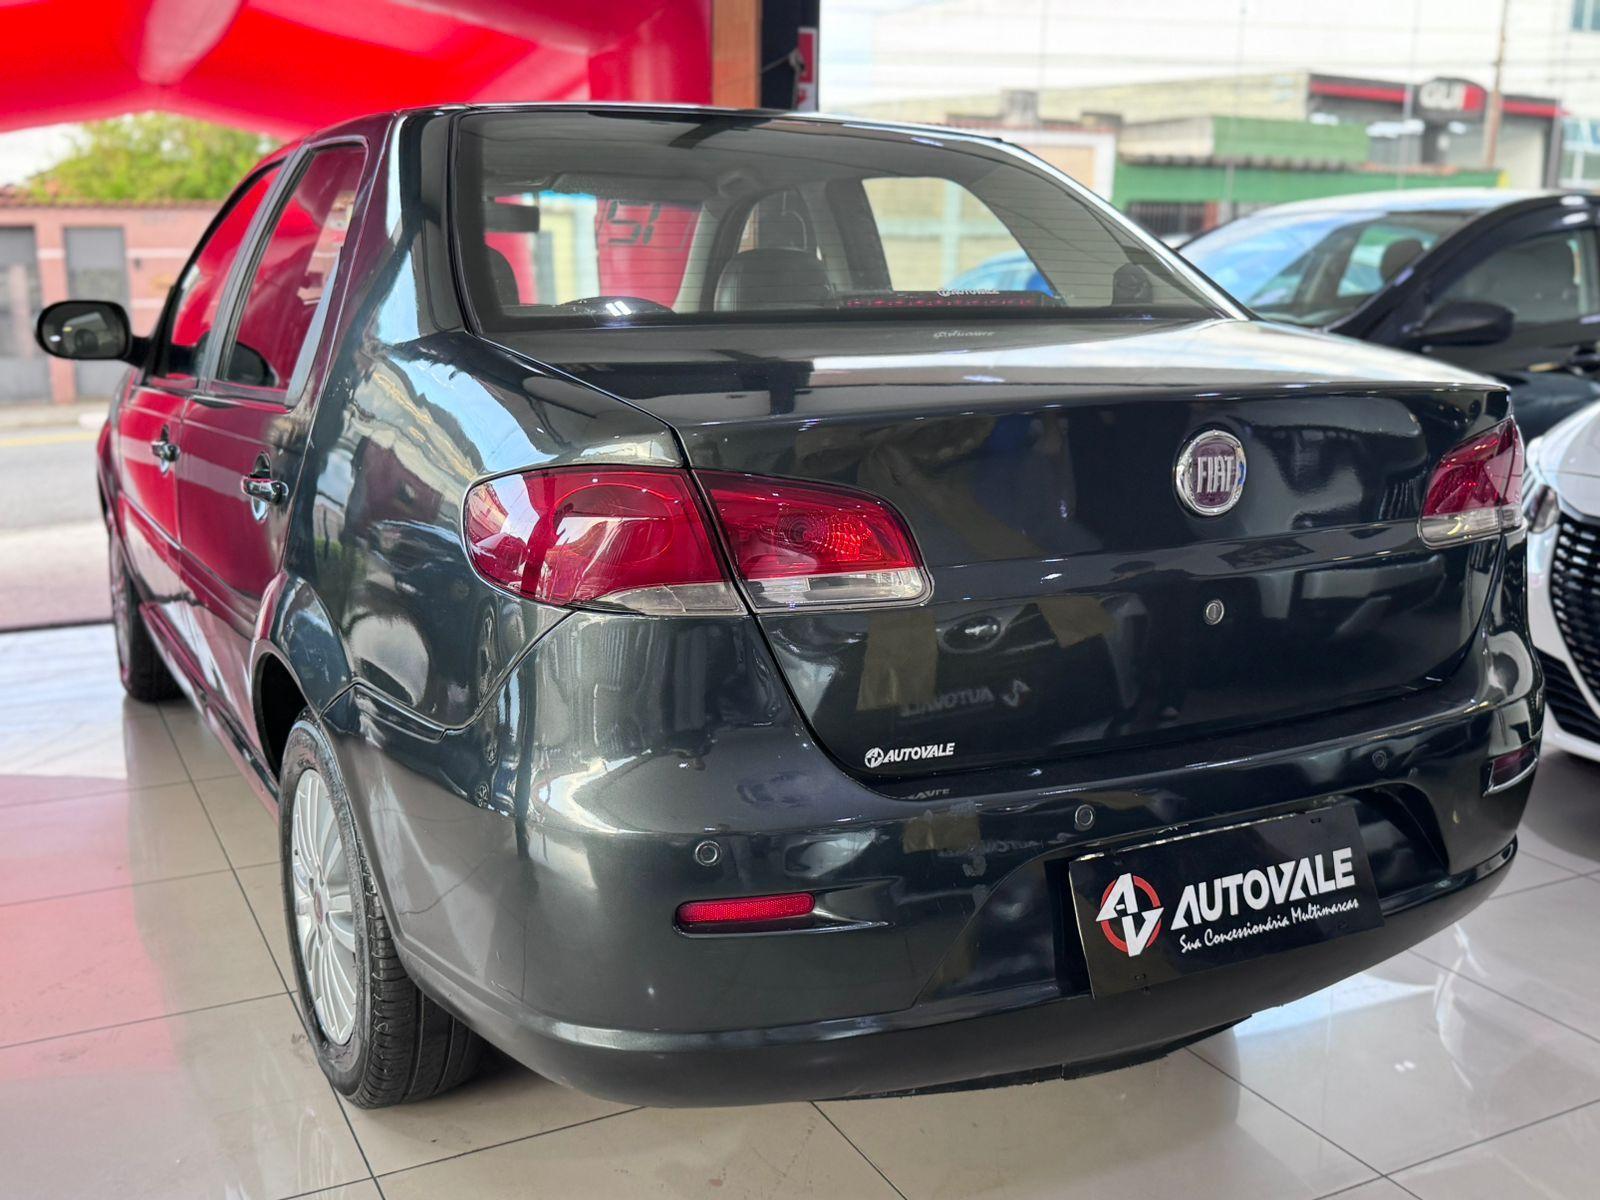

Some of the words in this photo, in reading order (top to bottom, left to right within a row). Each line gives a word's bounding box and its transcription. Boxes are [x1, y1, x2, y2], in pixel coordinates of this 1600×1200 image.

[1197, 455, 1234, 493] FIAT
[883, 742, 955, 763] AUTOVALE
[1169, 847, 1356, 931] AUTOVALE
[1179, 934, 1202, 954] Sua
[1204, 914, 1290, 947] Concessionária
[1291, 897, 1360, 925] Multimarcas
